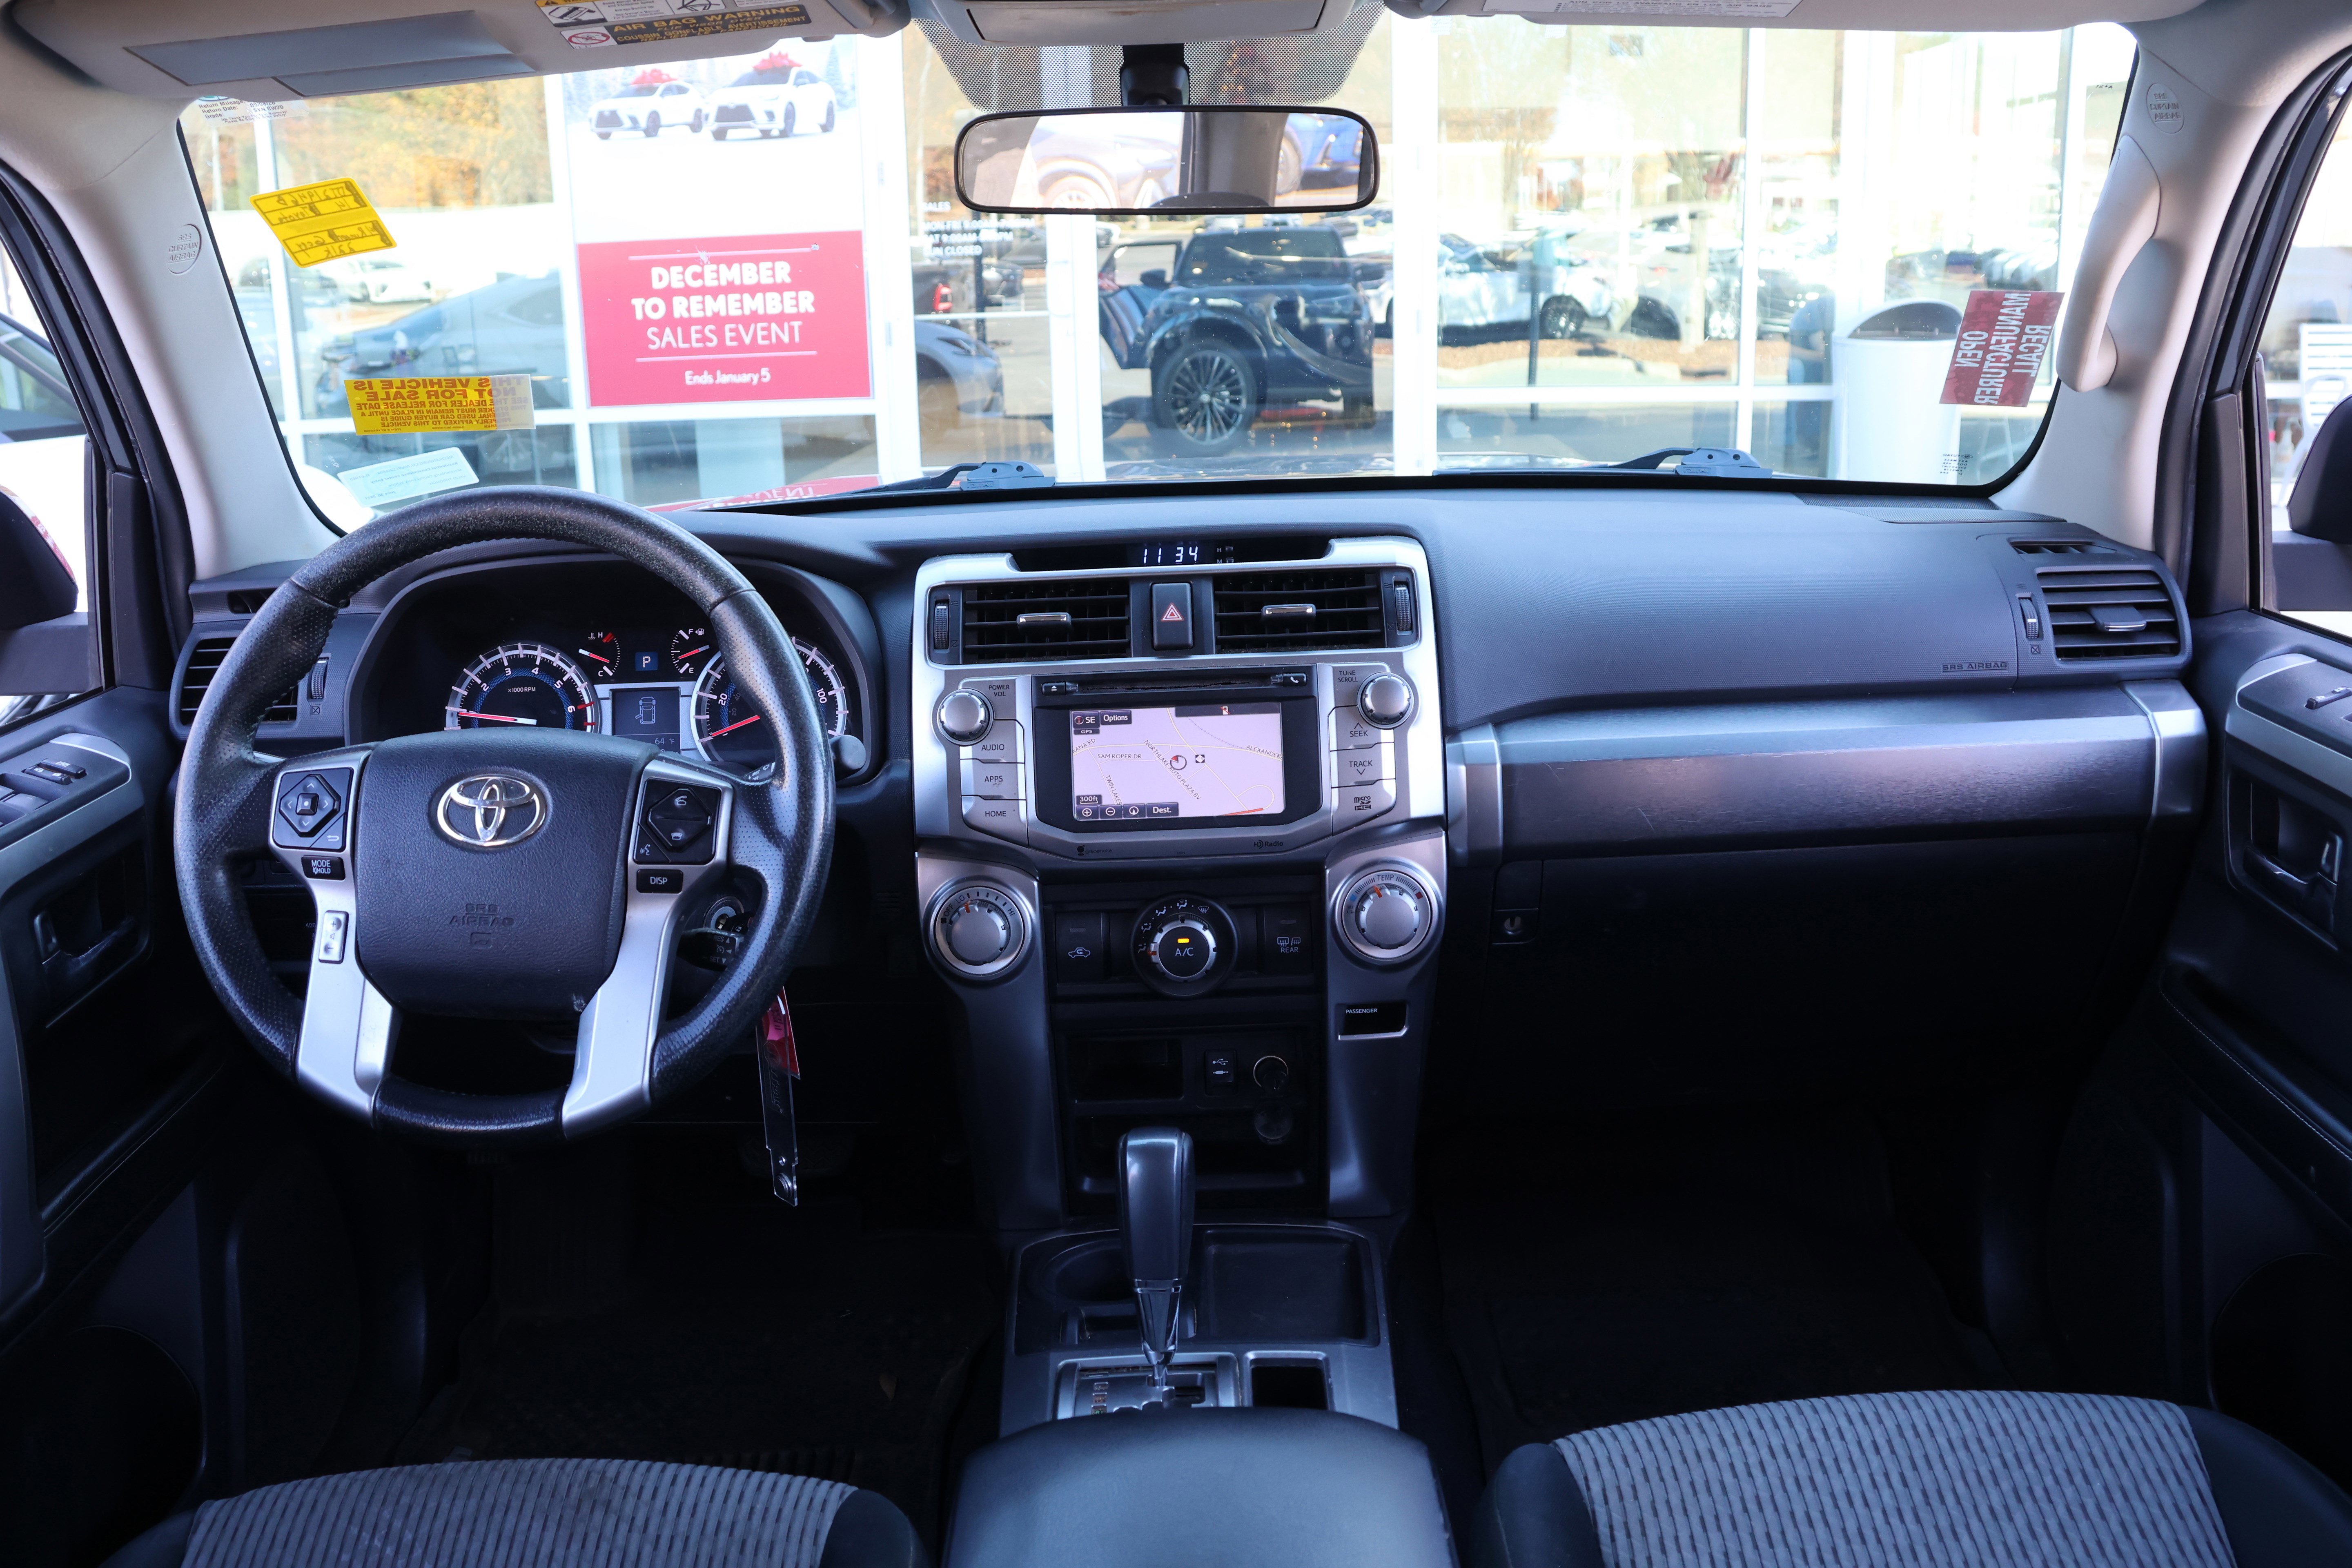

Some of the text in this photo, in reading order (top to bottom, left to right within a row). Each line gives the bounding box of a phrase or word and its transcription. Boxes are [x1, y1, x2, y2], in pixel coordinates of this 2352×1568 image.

[614, 7, 800, 32] AIR BAG WARNING
[664, 26, 722, 36] GONFLABLE
[728, 16, 806, 29] AVERTISSEMENT
[168, 242, 198, 252] CURTAIN
[944, 245, 982, 256] CLOSED
[651, 261, 791, 289] DECEMBER
[631, 290, 815, 320] TO REMEMBER
[646, 321, 803, 350] SALES EVENT
[684, 368, 771, 385] Ends January 5
[643, 656, 651, 668] P
[505, 667, 512, 676] 3
[481, 683, 489, 692] 2
[554, 679, 564, 688] 5
[718, 693, 728, 706] 20
[816, 688, 827, 704] 100
[1103, 714, 1128, 722] Options
[1144, 739, 1170, 768] NORTHLAKE
[1168, 766, 1182, 780] AUTO
[1180, 779, 1194, 795] PLAZA
[1105, 775, 1122, 805] TWIN LAKES
[943, 895, 1015, 917] OFF LO HI
[1175, 948, 1194, 956] A/C
